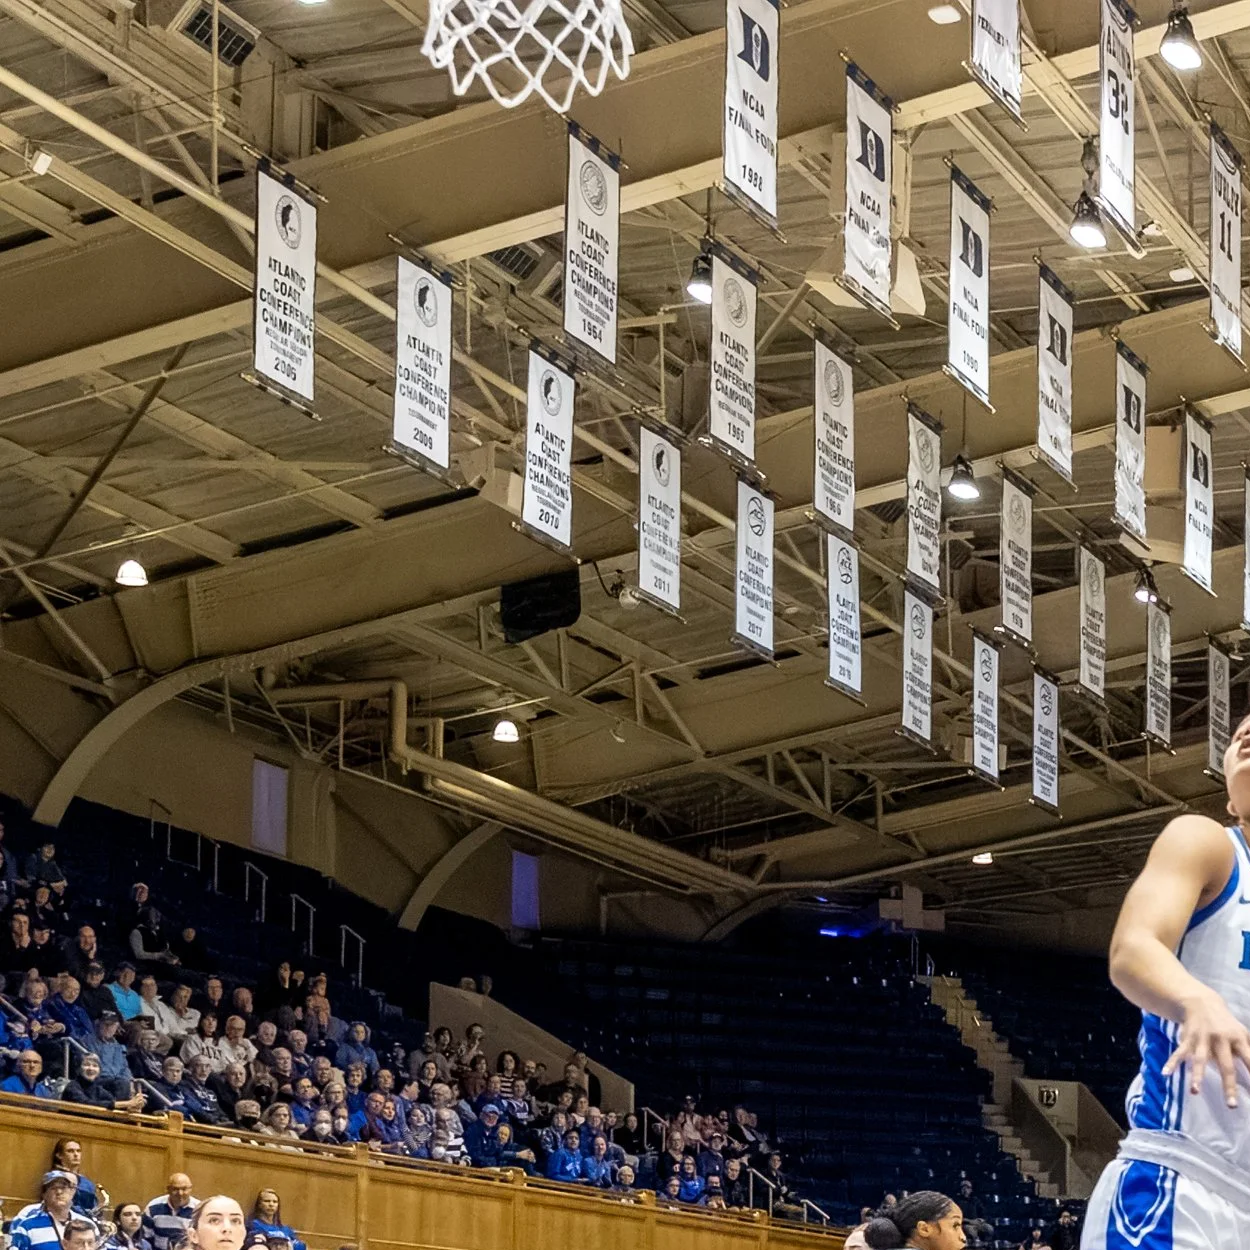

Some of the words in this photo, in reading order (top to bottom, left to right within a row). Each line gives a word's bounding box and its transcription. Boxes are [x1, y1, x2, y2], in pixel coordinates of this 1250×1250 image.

[743, 88, 766, 121] NCAA
[728, 106, 754, 141] FINAL
[741, 163, 764, 193] 1988
[860, 189, 882, 218] NCAA
[577, 218, 610, 255] ATLANTIC
[581, 240, 605, 263] COAST
[1219, 211, 1233, 263] 11
[268, 255, 307, 292] ATLANTIC
[569, 249, 616, 295] CONFERENCE
[273, 278, 302, 306] COAST
[570, 269, 614, 313] CHAMPIONS
[259, 287, 314, 333] CONFERENCE
[261, 307, 312, 349] CHAMPIONS
[582, 318, 603, 344] 1964
[406, 334, 444, 366] ATLANTIC
[720, 331, 749, 363] ATLANTIC
[963, 350, 979, 373] 1990
[273, 357, 298, 382] 2006
[413, 354, 438, 380] COAST
[724, 351, 745, 375] COAST
[398, 364, 448, 405] CONFERENCE
[715, 379, 753, 415] CHAMPIONS
[398, 384, 447, 420] CHAMPIONS
[413, 427, 434, 451] 2009
[534, 421, 566, 452] ATLANTIC
[540, 439, 561, 465] COAST
[538, 508, 560, 530] 2010
[647, 494, 675, 521] ATLANTIC
[745, 545, 769, 569] ATLANTIC
[653, 575, 671, 594] 2011
[748, 621, 763, 639] 2017
